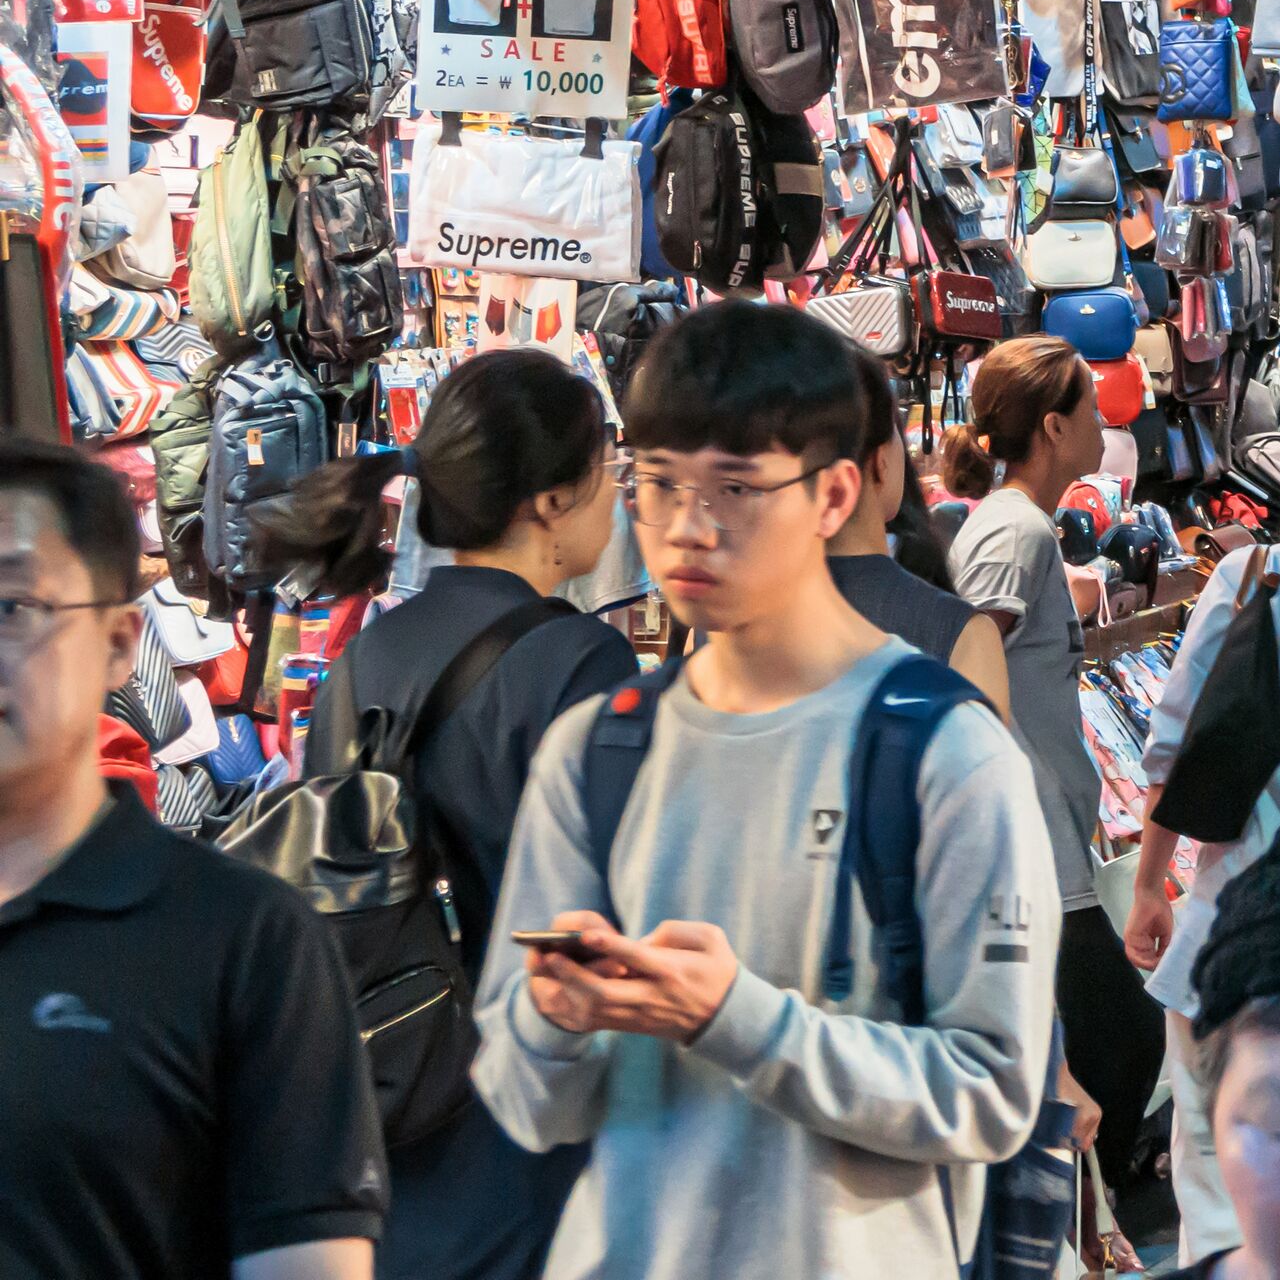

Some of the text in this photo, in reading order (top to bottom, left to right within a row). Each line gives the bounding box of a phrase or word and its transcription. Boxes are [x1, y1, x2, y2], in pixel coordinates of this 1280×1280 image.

[788, 7, 798, 50] Supreme
[137, 14, 194, 112] Supreme
[481, 39, 567, 63] SALE
[435, 70, 466, 89] 2EA
[522, 68, 604, 95] 10,000
[436, 223, 581, 267] Supreme
